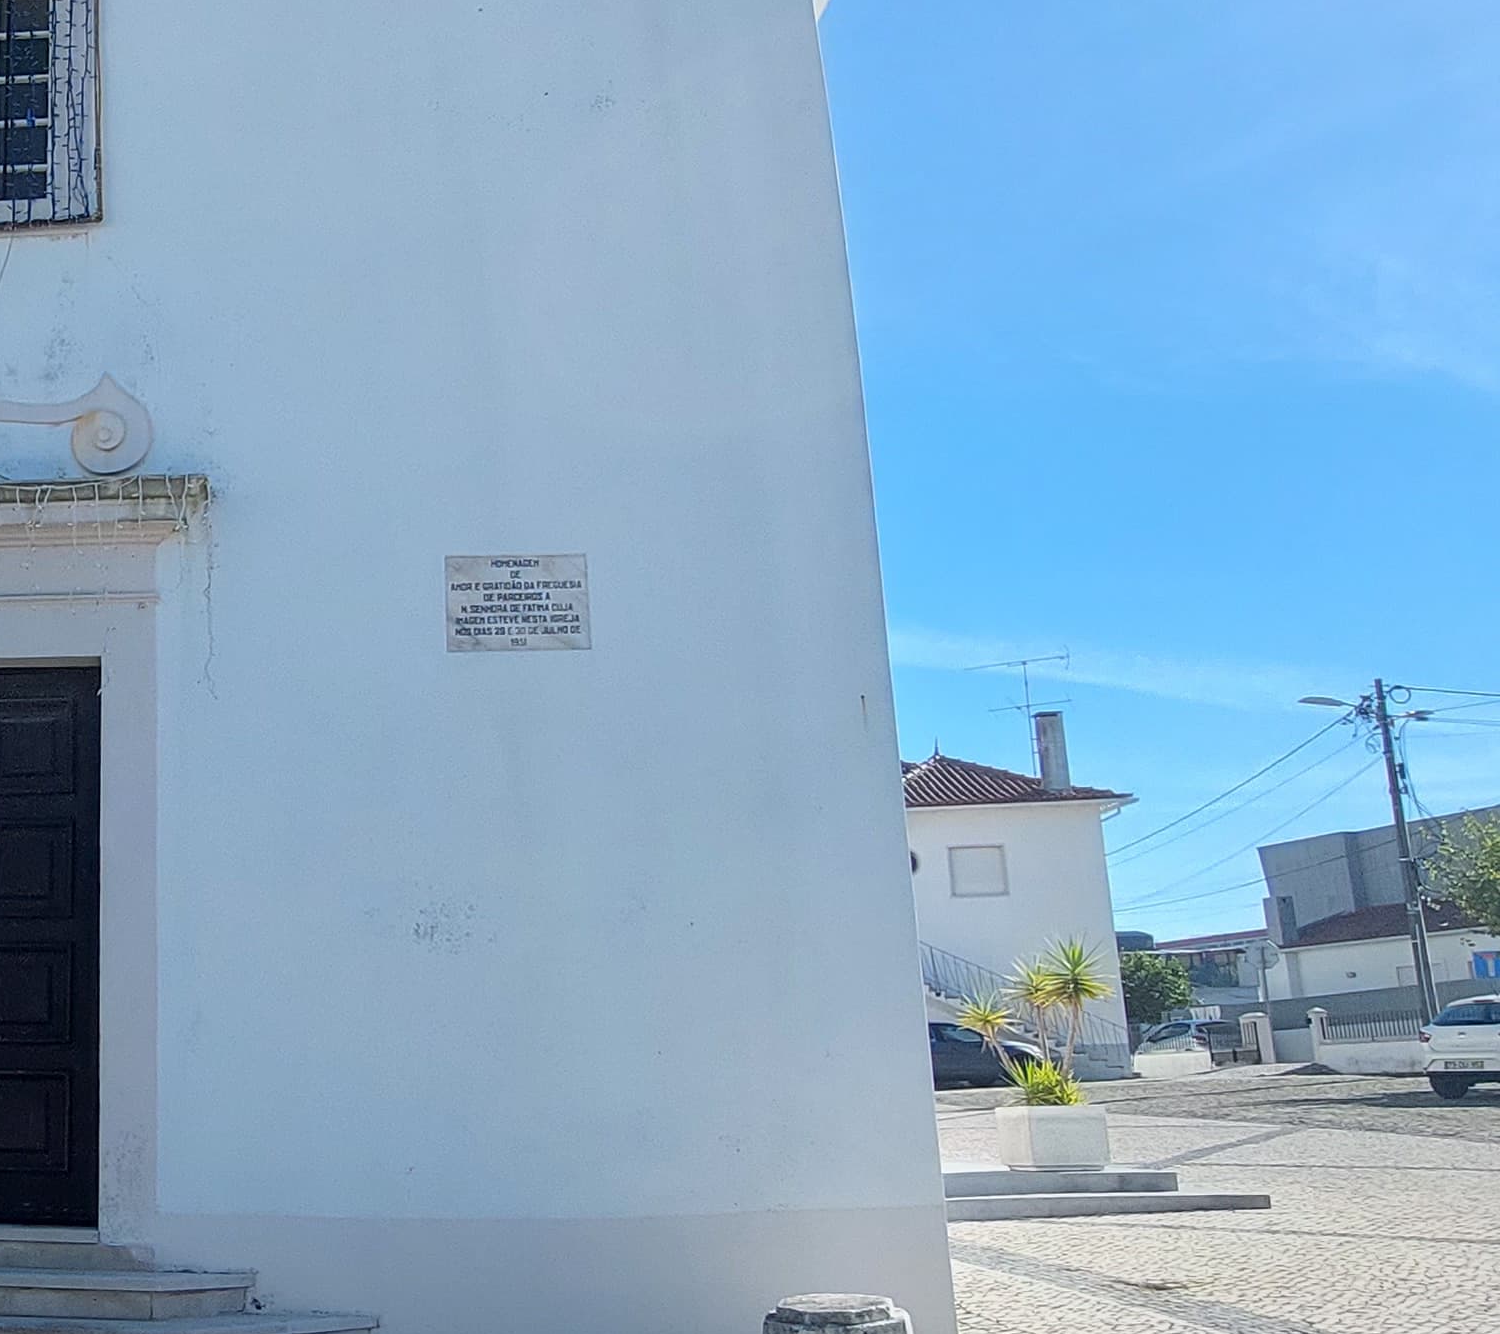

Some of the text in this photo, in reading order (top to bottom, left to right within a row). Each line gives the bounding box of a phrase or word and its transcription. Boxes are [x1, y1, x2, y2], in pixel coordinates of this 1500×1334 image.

[490, 559, 539, 567] HOMENAGEM
[510, 570, 521, 578] DE
[450, 580, 582, 591] AMOR E GRATIDÃO DA FREGUESIA
[483, 594, 495, 602] DE
[497, 592, 543, 601] PARCEIROS
[470, 604, 507, 613] SENHORA
[510, 604, 520, 612] DE
[552, 603, 573, 611] CUJA
[456, 614, 580, 625] IMAGEM ESTEVE NESTA IGREJA
[474, 627, 494, 635] DIAS
[508, 627, 512, 635] E
[528, 626, 539, 635] DE
[541, 625, 568, 634] JULHO
[570, 625, 581, 633] DE
